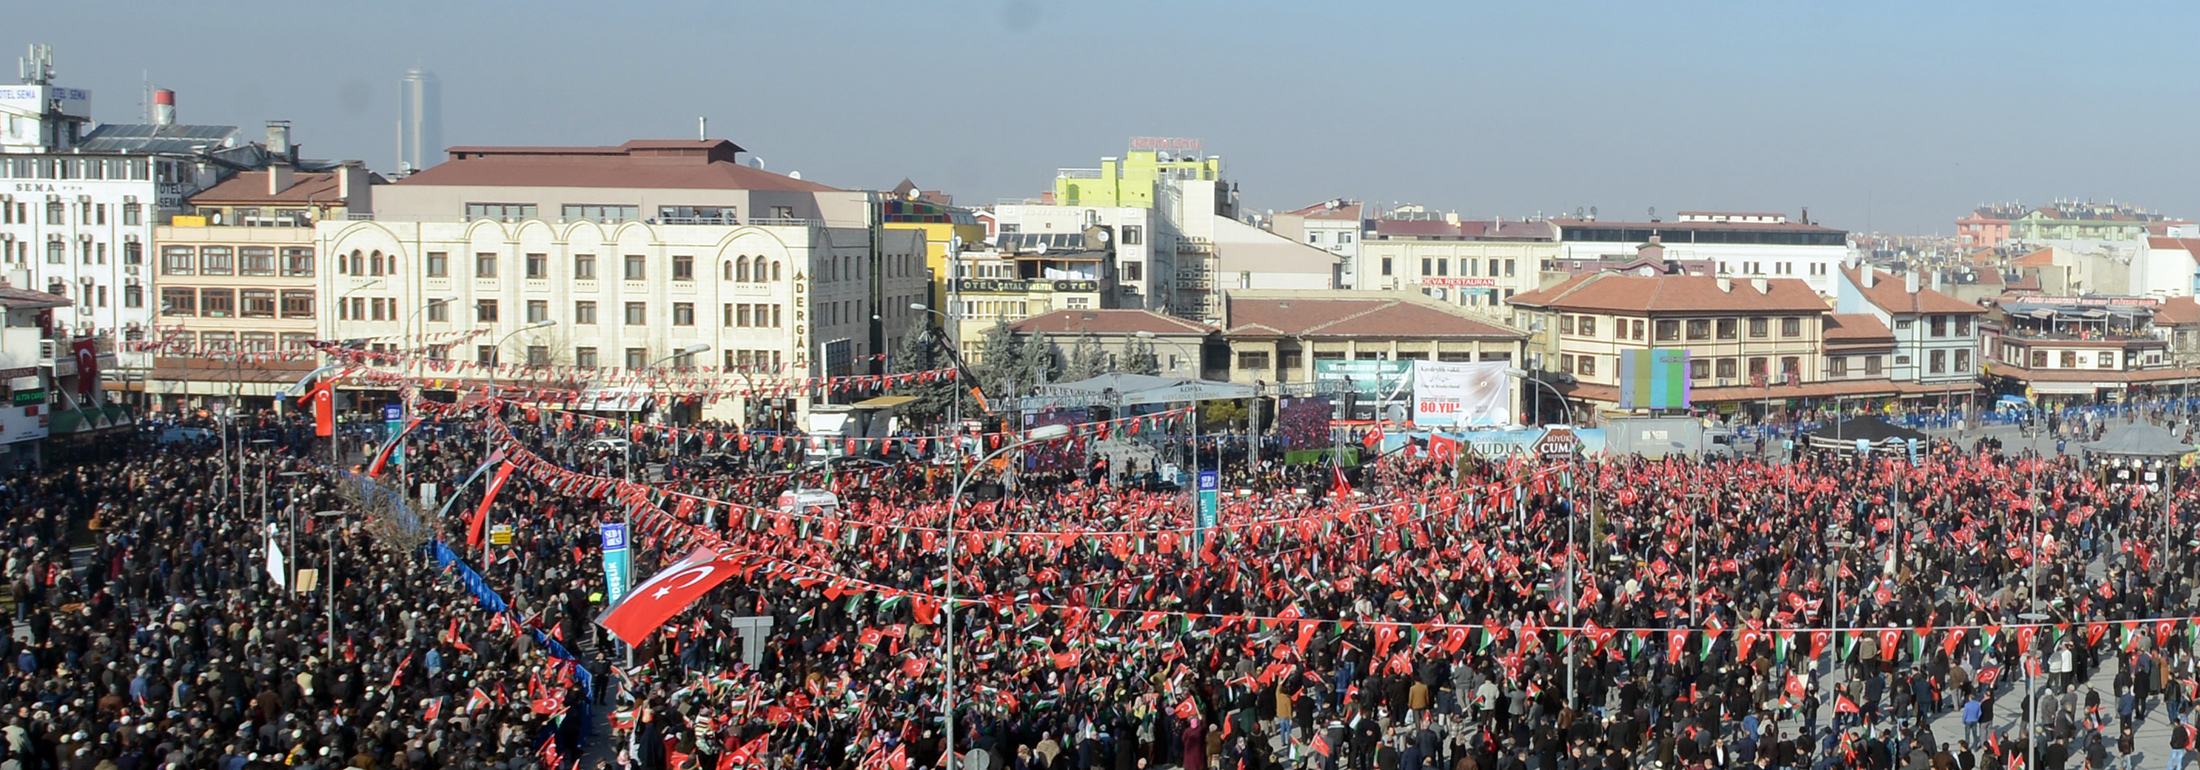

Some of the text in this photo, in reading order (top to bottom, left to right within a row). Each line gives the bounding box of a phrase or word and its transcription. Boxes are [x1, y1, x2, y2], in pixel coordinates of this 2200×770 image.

[17, 90, 35, 99] SEMA
[52, 88, 86, 99] OTEL SEMA
[16, 183, 55, 192] SEMA
[160, 184, 181, 194] OTEL
[159, 198, 181, 208] SEMA
[963, 282, 992, 291] OTEL
[998, 282, 1023, 292] ÇATAL
[1059, 282, 1095, 290] OTEL
[1541, 442, 1571, 454] CUM
